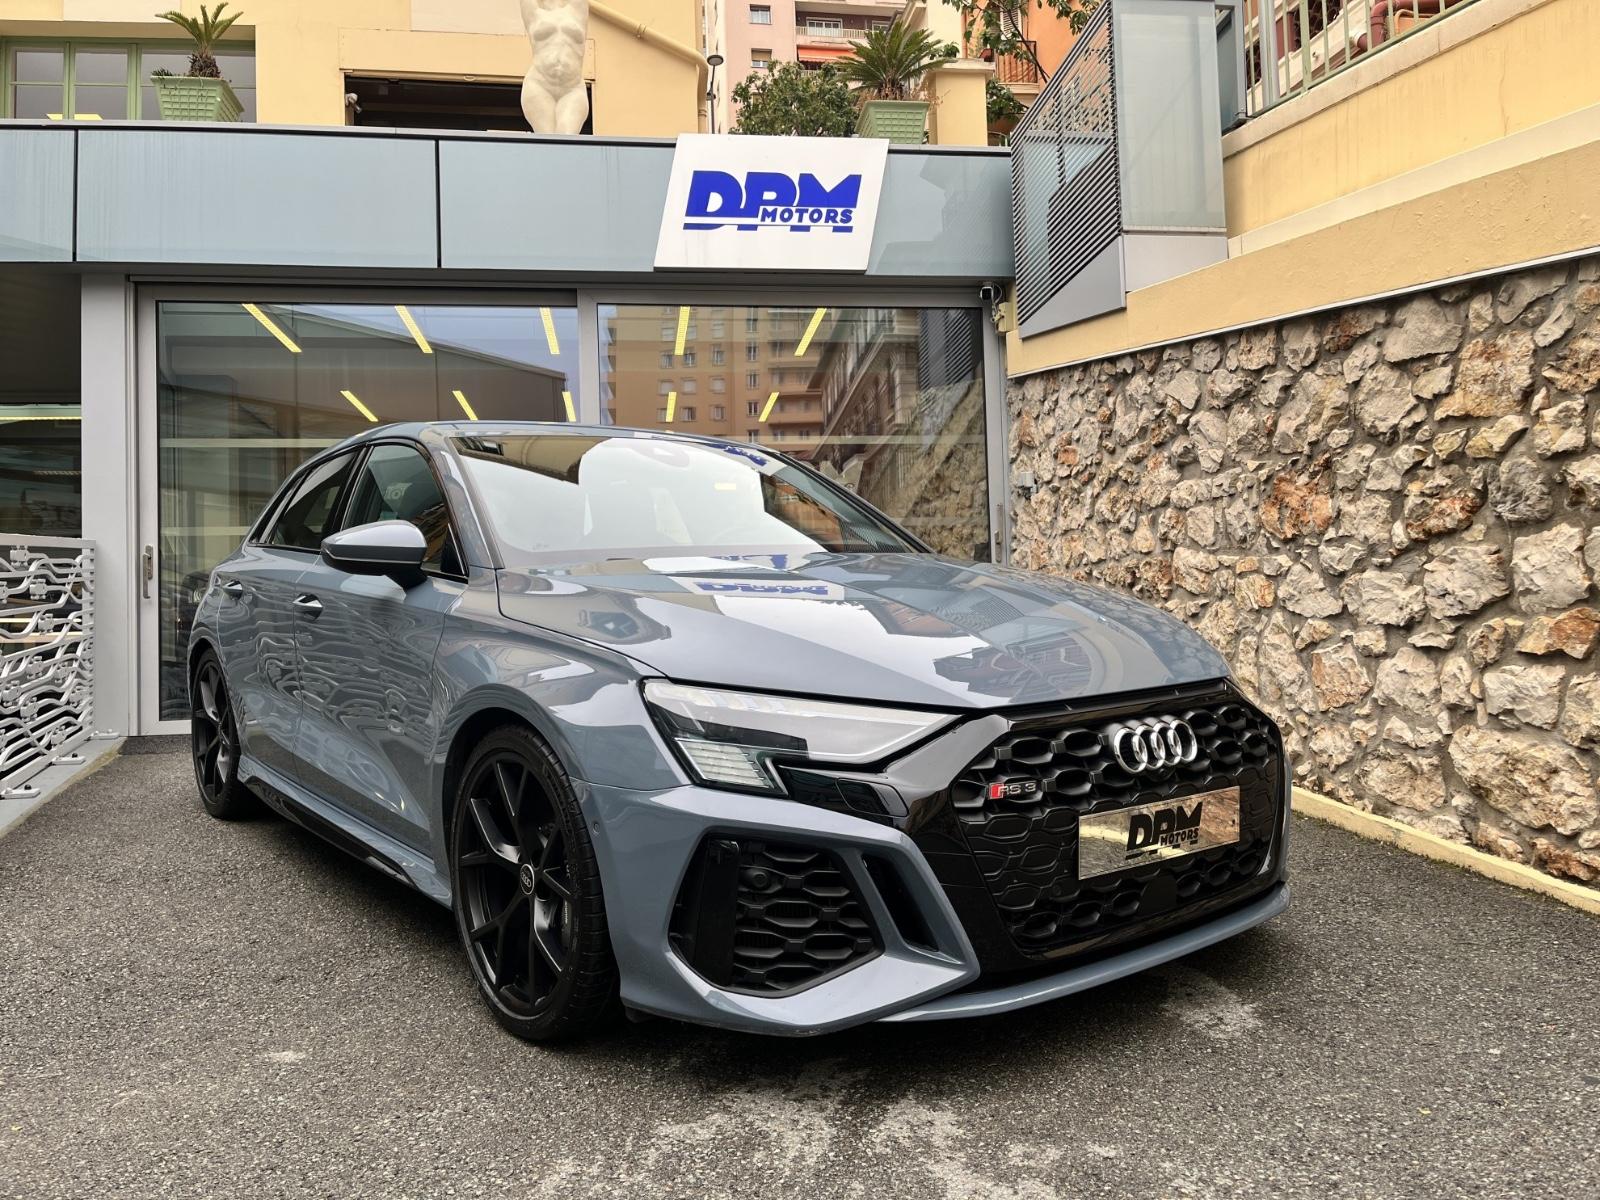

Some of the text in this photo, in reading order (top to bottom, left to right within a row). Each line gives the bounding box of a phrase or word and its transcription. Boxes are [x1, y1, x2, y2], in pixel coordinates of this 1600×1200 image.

[683, 170, 862, 233] DPM
[760, 207, 853, 224] MOTORS
[997, 782, 1037, 798] RS 3
[1125, 802, 1203, 860] DPM
[1160, 828, 1199, 846] MOTORS
